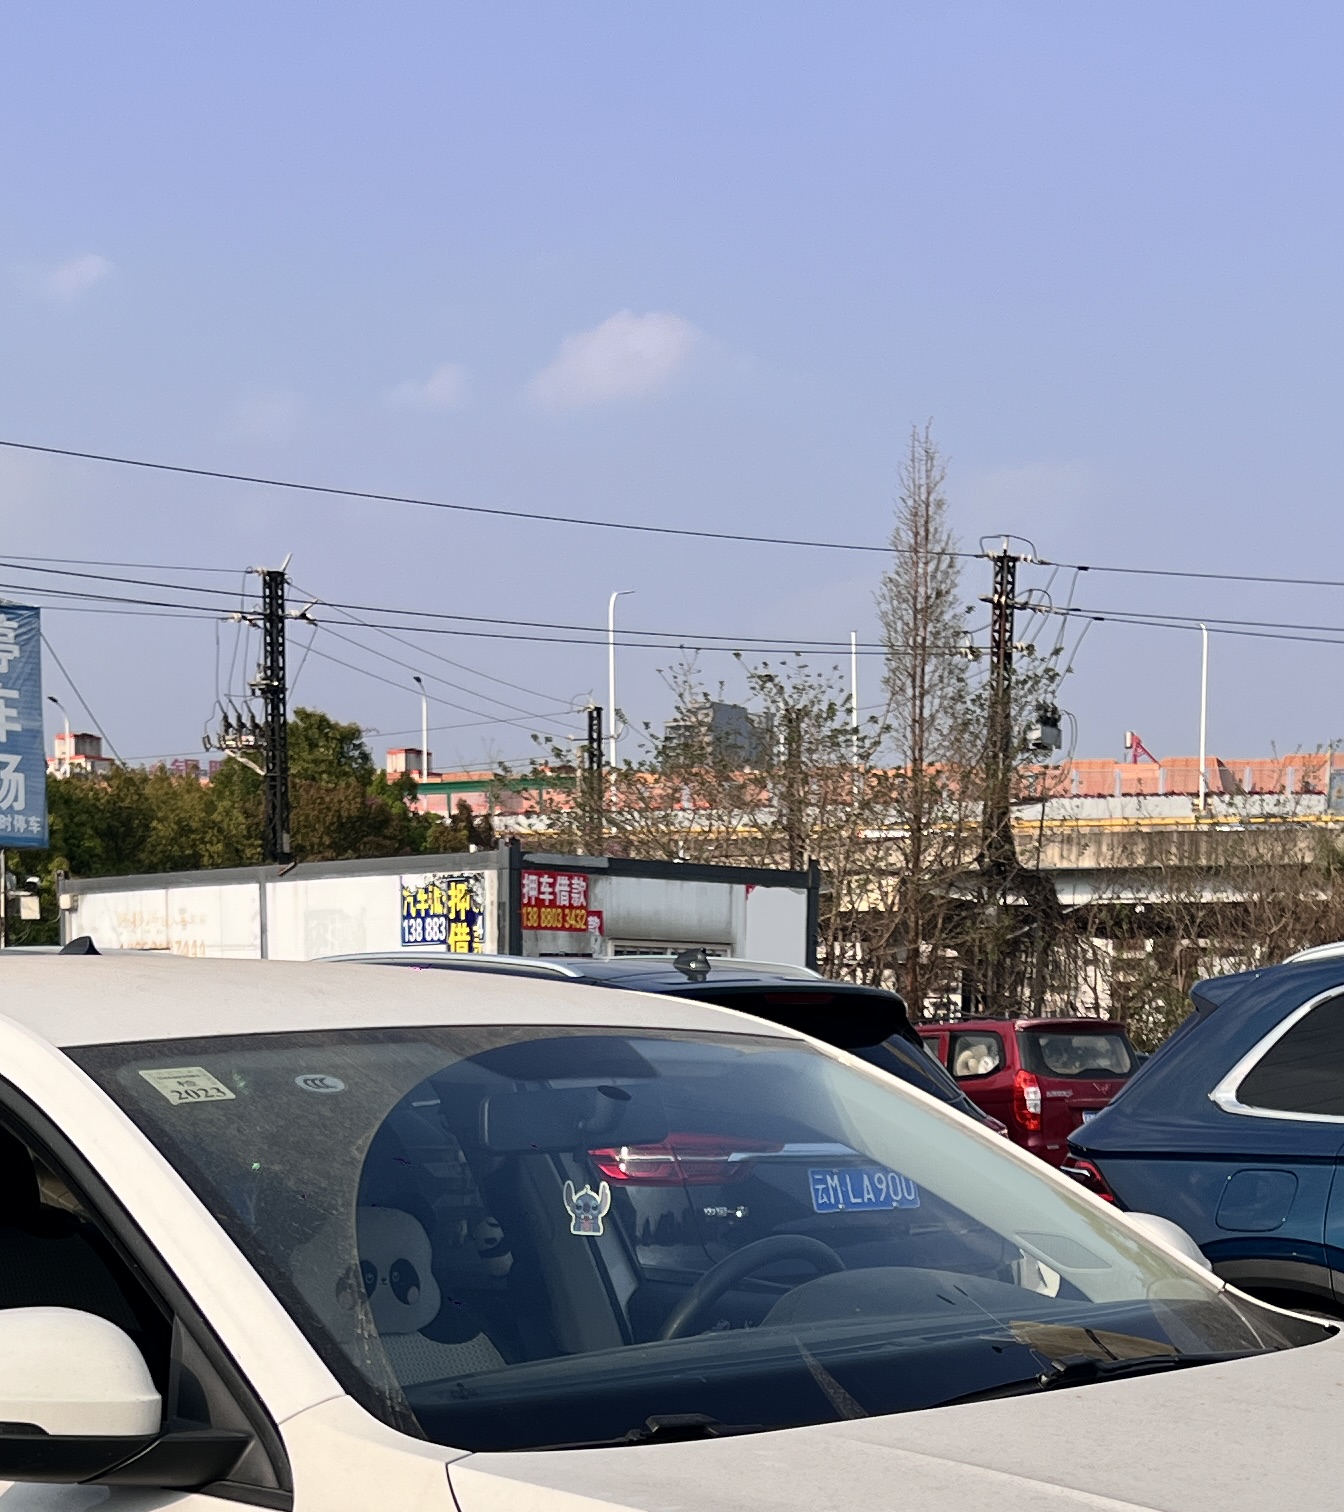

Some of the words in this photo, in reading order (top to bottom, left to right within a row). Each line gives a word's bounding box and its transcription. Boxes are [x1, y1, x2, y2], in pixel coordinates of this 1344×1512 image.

[522, 873, 587, 907] 押车借款
[403, 917, 423, 942] 138
[171, 1087, 227, 1100] 2023
